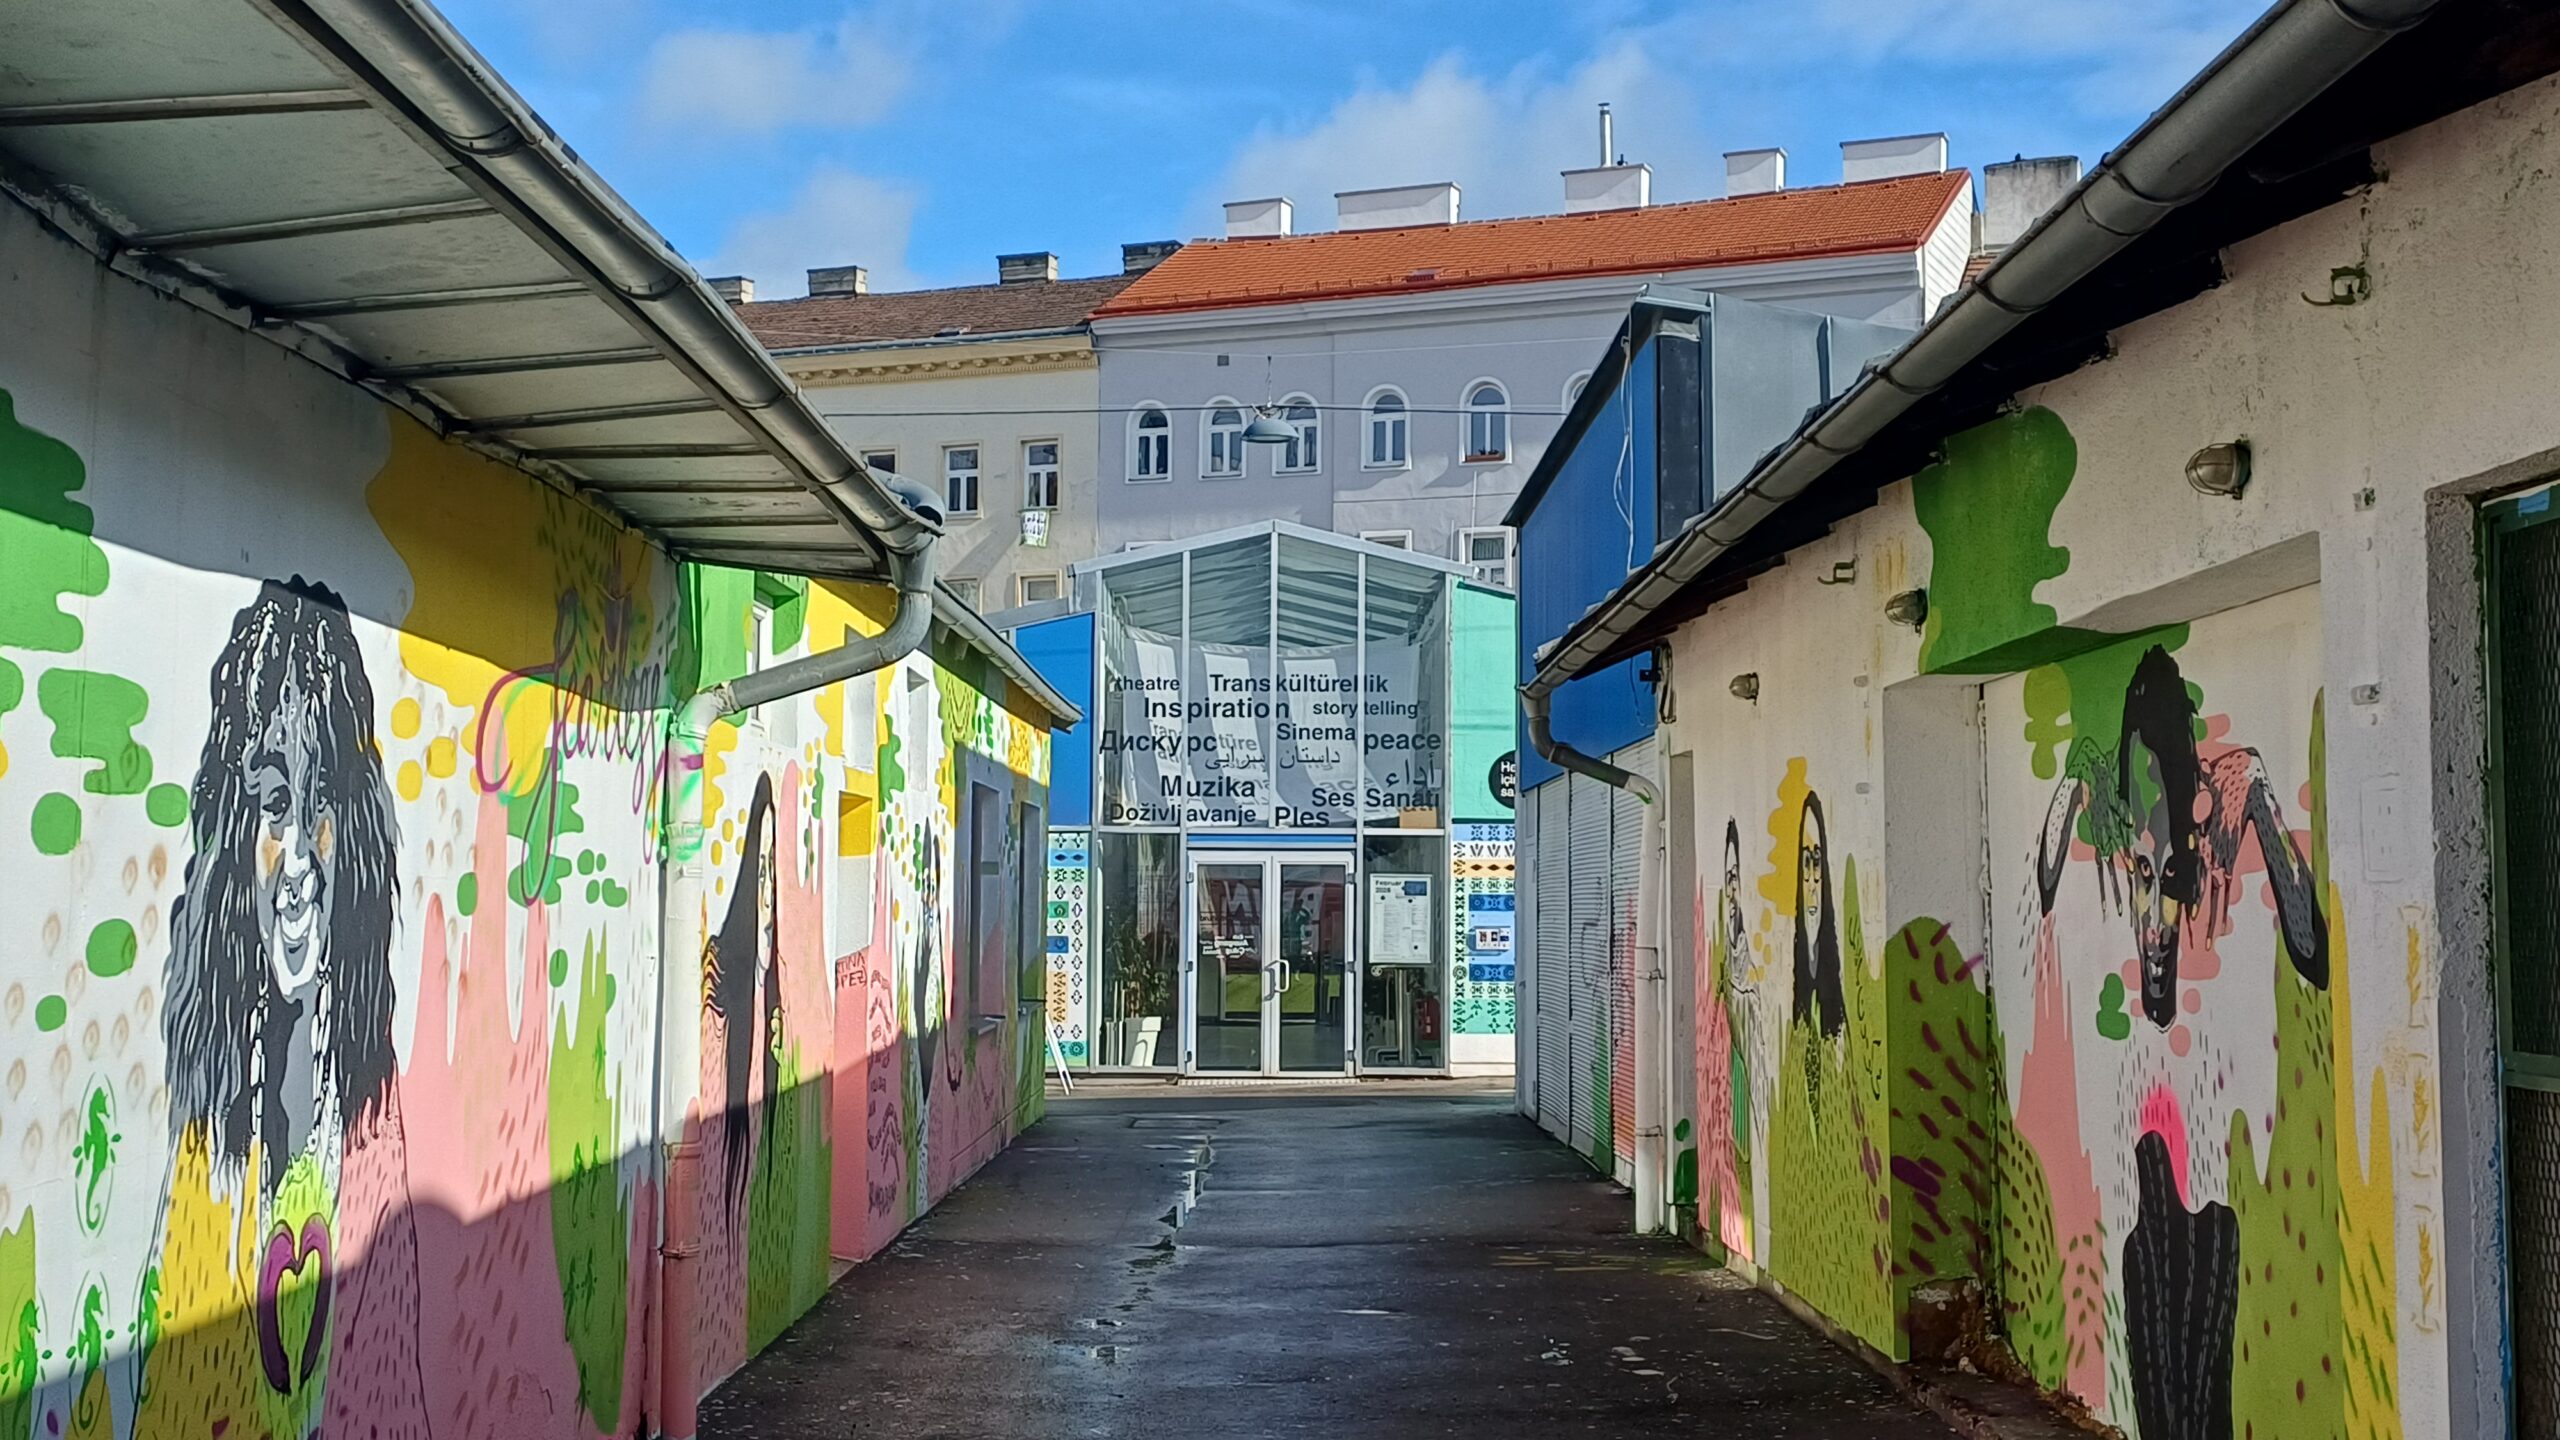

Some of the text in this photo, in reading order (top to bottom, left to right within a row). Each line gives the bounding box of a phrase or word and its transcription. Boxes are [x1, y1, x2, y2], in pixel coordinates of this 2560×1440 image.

[1115, 676, 1180, 692] theatre
[1144, 697, 1290, 724] Inspiration
[1313, 700, 1418, 719] storytelling
[1276, 723, 1356, 741] Sinema
[1099, 730, 1218, 757] Дискурс
[1364, 732, 1442, 755] peace
[1161, 775, 1256, 797] Muzika
[1312, 787, 1355, 807] Ses
[1275, 806, 1330, 827] Ples
